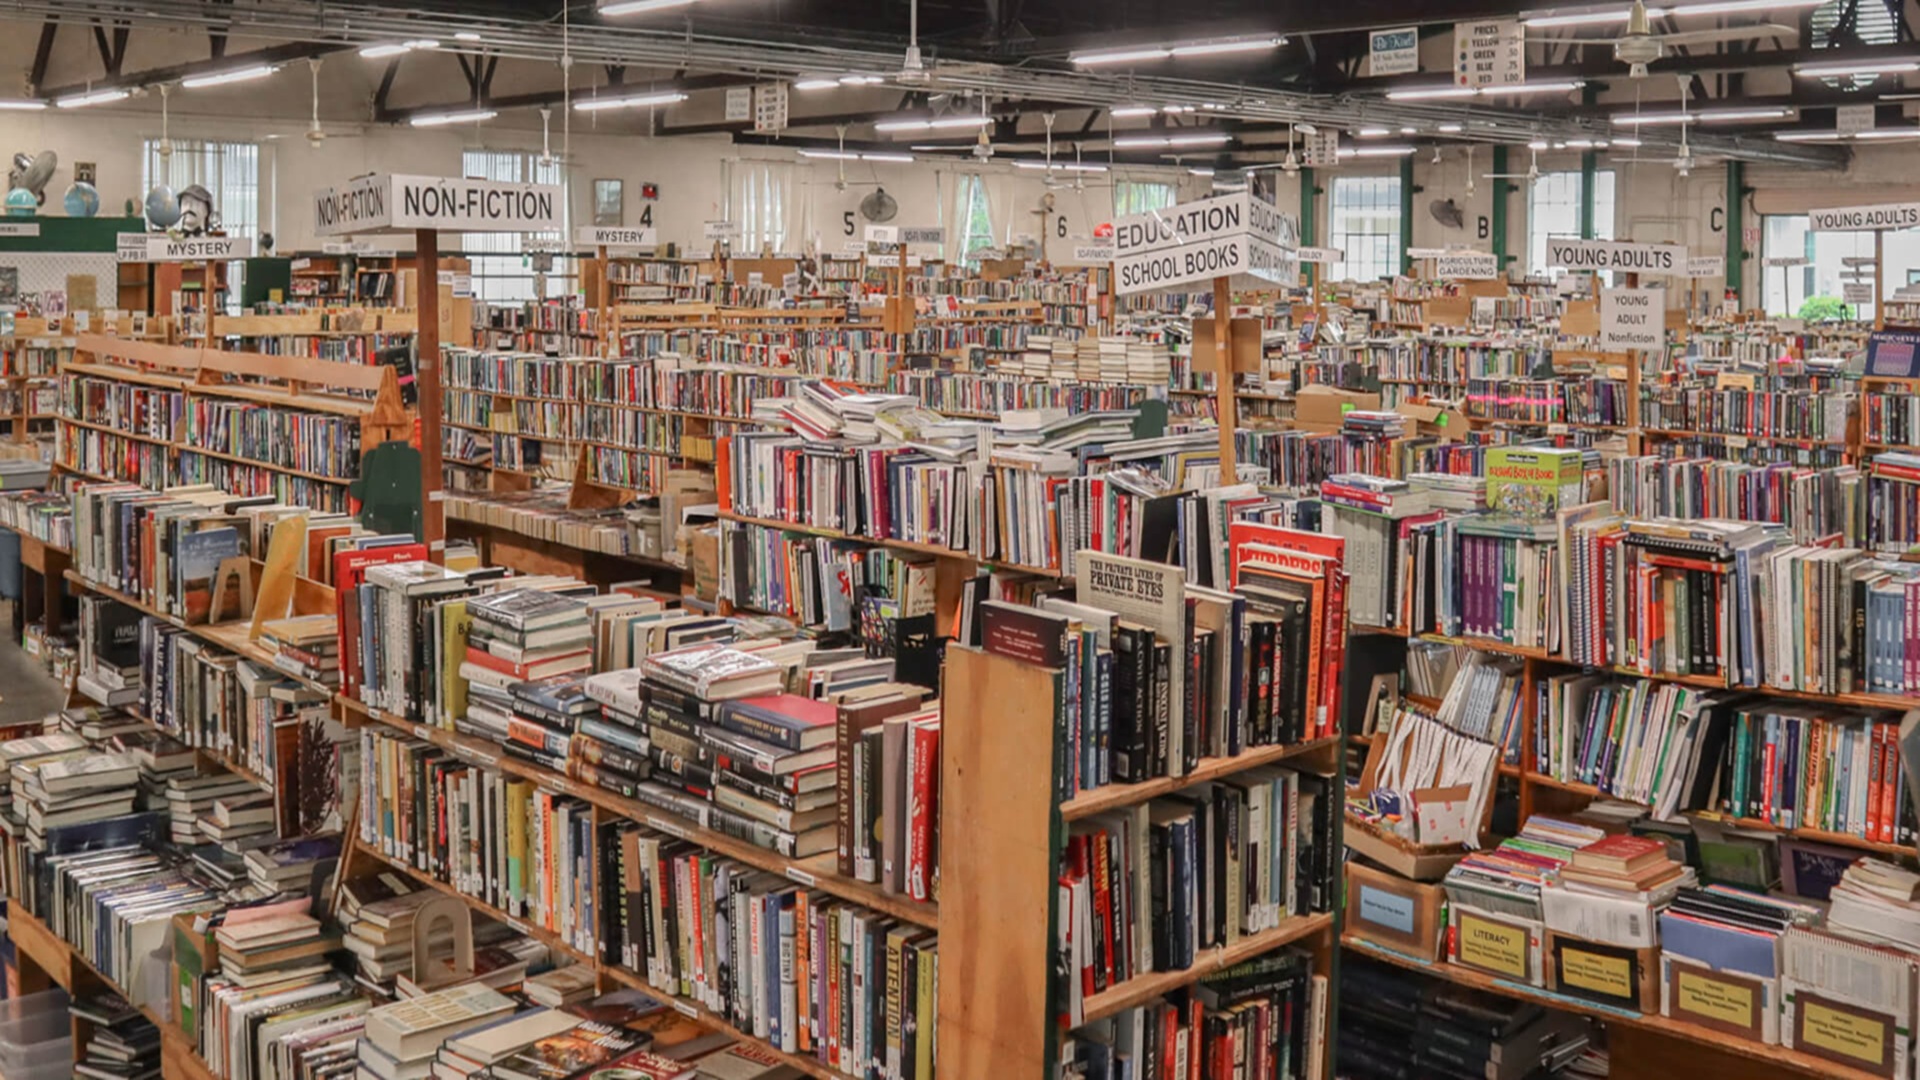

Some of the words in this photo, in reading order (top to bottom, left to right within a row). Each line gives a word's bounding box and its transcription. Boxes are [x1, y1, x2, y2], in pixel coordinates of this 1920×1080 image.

[1474, 25, 1499, 35] PRICES
[1472, 38, 1499, 47] YELLOW
[1473, 50, 1496, 59] GREEN
[1476, 62, 1493, 71] BLUE
[1508, 61, 1518, 70] .75
[1478, 74, 1492, 83] RED
[1504, 74, 1519, 82] 1.00
[318, 186, 384, 227] NON-FICTION
[404, 185, 552, 220] NON-FICTION
[640, 204, 652, 228] 4
[844, 211, 855, 236] 5
[1117, 203, 1241, 249] EDUCATION
[1711, 206, 1723, 232] C
[1816, 213, 1862, 228] YOUNG
[1865, 208, 1918, 225] ADULTS
[596, 230, 644, 243] MYSTERY
[1057, 215, 1067, 238] 6
[1478, 216, 1489, 239] B
[167, 242, 232, 256] MYSTERY
[1250, 244, 1273, 273] SCHOOL
[1553, 247, 1607, 266] YOUNG
[1611, 249, 1673, 268] ADULTS
[1122, 255, 1182, 287] SCHOOL
[1185, 244, 1240, 275] BOOKS
[1439, 257, 1494, 265] AGRICULTURE
[1439, 267, 1494, 276] GARDENING
[1614, 296, 1648, 306] YOUNG
[1616, 315, 1647, 325] ADULT
[1608, 332, 1656, 344] Nonfiction
[1605, 547, 1613, 567] ART
[1090, 560, 1103, 571] THE
[1104, 562, 1133, 576] PRIVATE
[1134, 567, 1153, 580] LIVES
[1154, 570, 1164, 581] OF
[1605, 569, 1613, 580] IN
[1090, 570, 1134, 592] PRIVATE
[1137, 580, 1164, 598] EYES
[1605, 583, 1613, 615] FOCUS
[1856, 608, 1864, 628] LIES
[840, 713, 848, 746] THE
[840, 751, 848, 825] LIBRARY
[797, 908, 805, 961] CIRCLES
[1474, 929, 1510, 946] LITERACY
[782, 959, 790, 979] TINY
[887, 946, 899, 1040] ATTENTION
